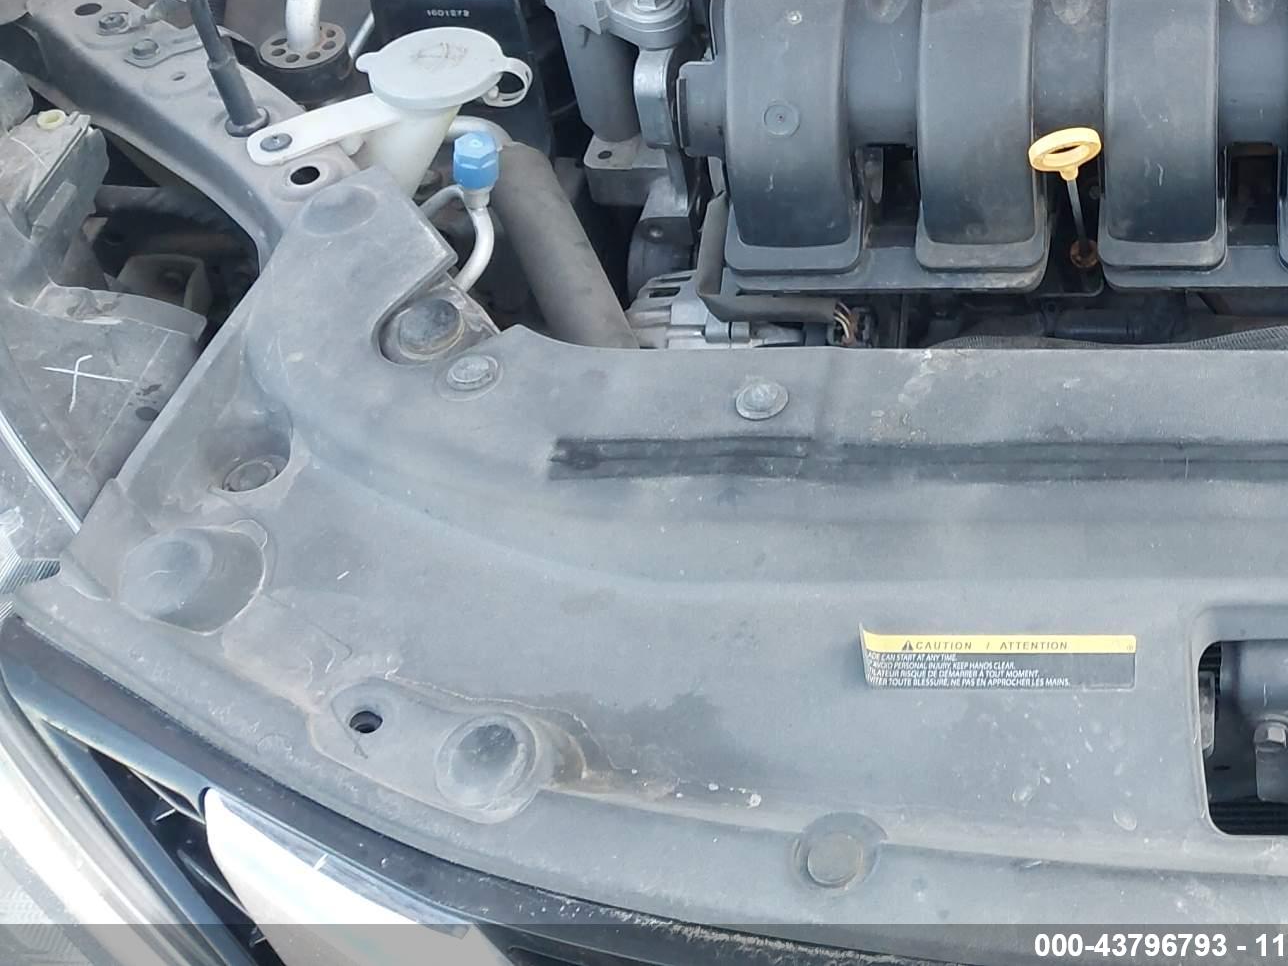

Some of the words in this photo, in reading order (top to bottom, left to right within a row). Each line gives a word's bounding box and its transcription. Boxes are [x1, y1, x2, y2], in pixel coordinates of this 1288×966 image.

[915, 640, 972, 651] CAUTION
[999, 640, 1068, 651] ATTENTION
[986, 669, 1005, 679] TOUT
[889, 677, 913, 687] TOUTE
[950, 677, 961, 687] NE
[961, 677, 976, 687] PAS
[976, 677, 987, 687] EN
[1031, 677, 1044, 687] LES
